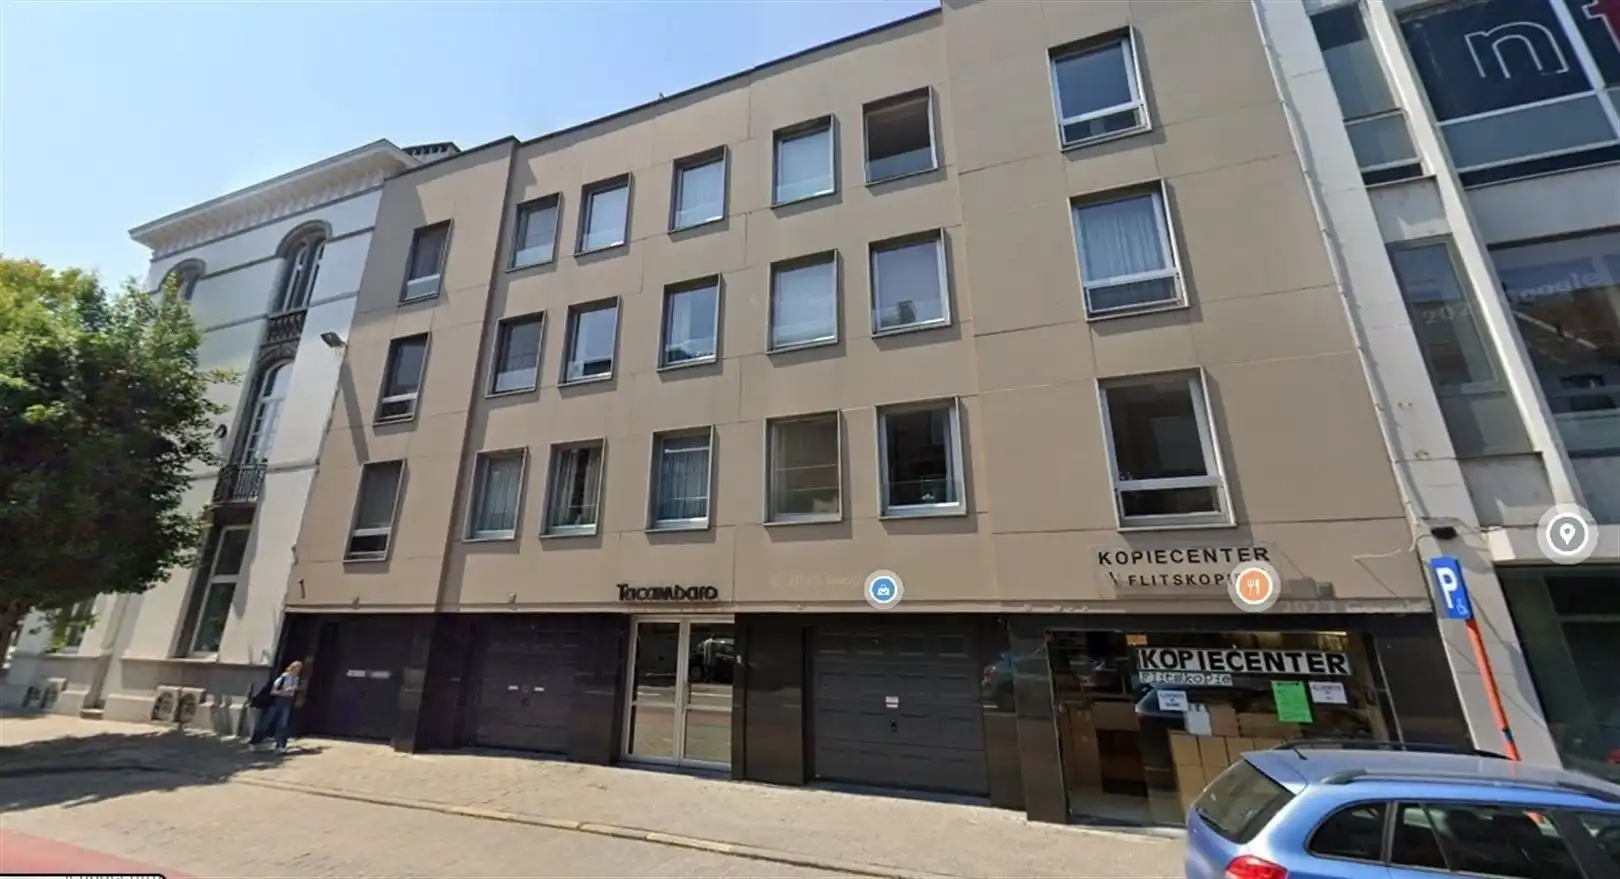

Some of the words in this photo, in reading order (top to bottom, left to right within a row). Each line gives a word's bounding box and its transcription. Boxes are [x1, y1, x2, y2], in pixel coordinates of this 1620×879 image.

[1098, 547, 1271, 566] KOPIECENTER
[1436, 567, 1458, 609] P
[1139, 649, 1348, 674] KOPIECENTER
